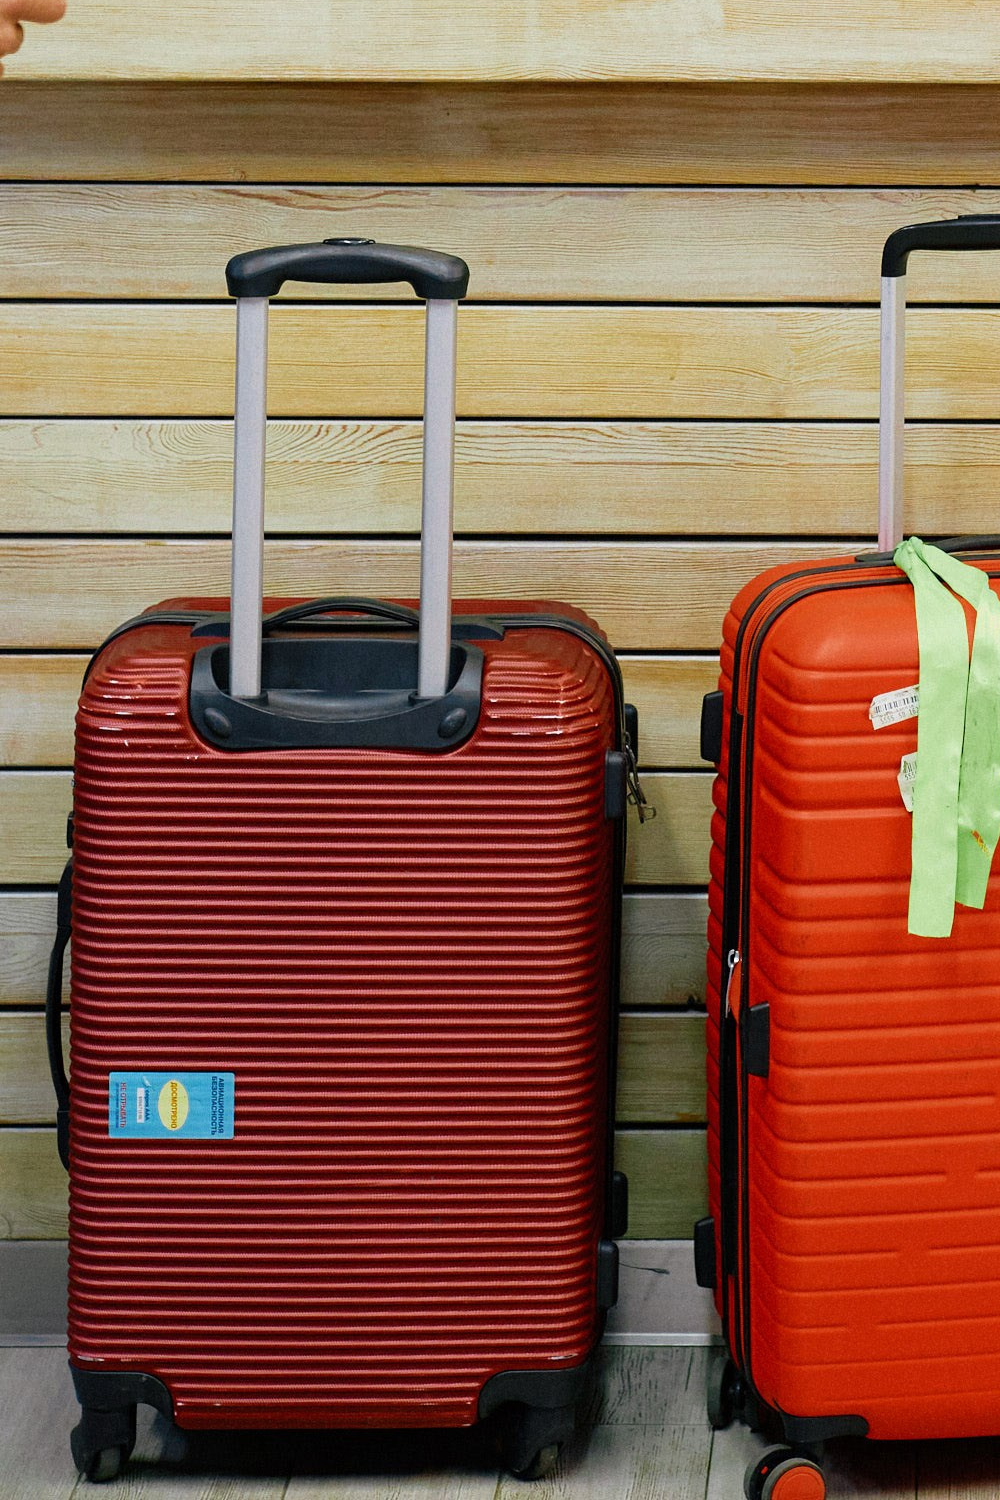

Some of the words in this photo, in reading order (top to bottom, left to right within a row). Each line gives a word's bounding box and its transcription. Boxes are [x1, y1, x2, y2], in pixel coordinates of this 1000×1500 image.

[120, 1082, 126, 1091] НЕ
[169, 1082, 178, 1130] ДОСМОТРЕНО
[210, 1076, 218, 1135] БЕЗОПАСНОСТЬ
